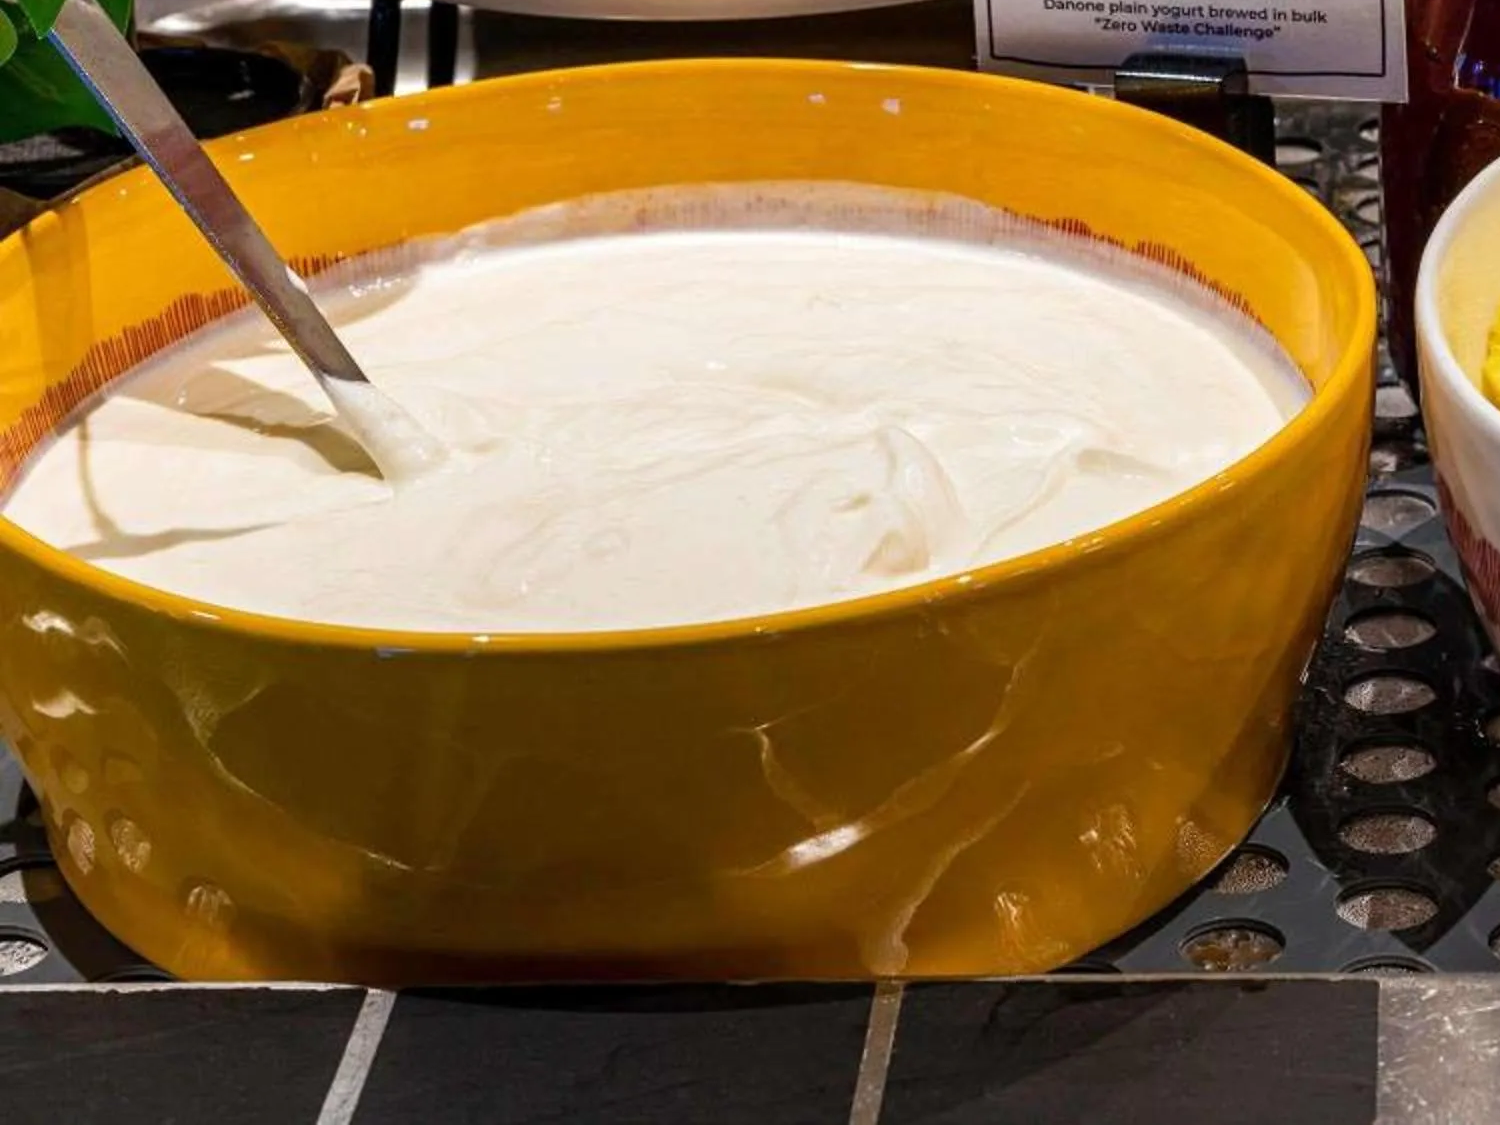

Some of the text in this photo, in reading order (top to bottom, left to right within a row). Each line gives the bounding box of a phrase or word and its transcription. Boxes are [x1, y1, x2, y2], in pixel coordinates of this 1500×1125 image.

[1109, 0, 1148, 18] plain
[1151, 4, 1204, 19] yogurt
[1208, 6, 1267, 21] brewed
[1274, 7, 1287, 21] in
[1293, 9, 1328, 24] bulk
[1143, 21, 1191, 35] Waste
